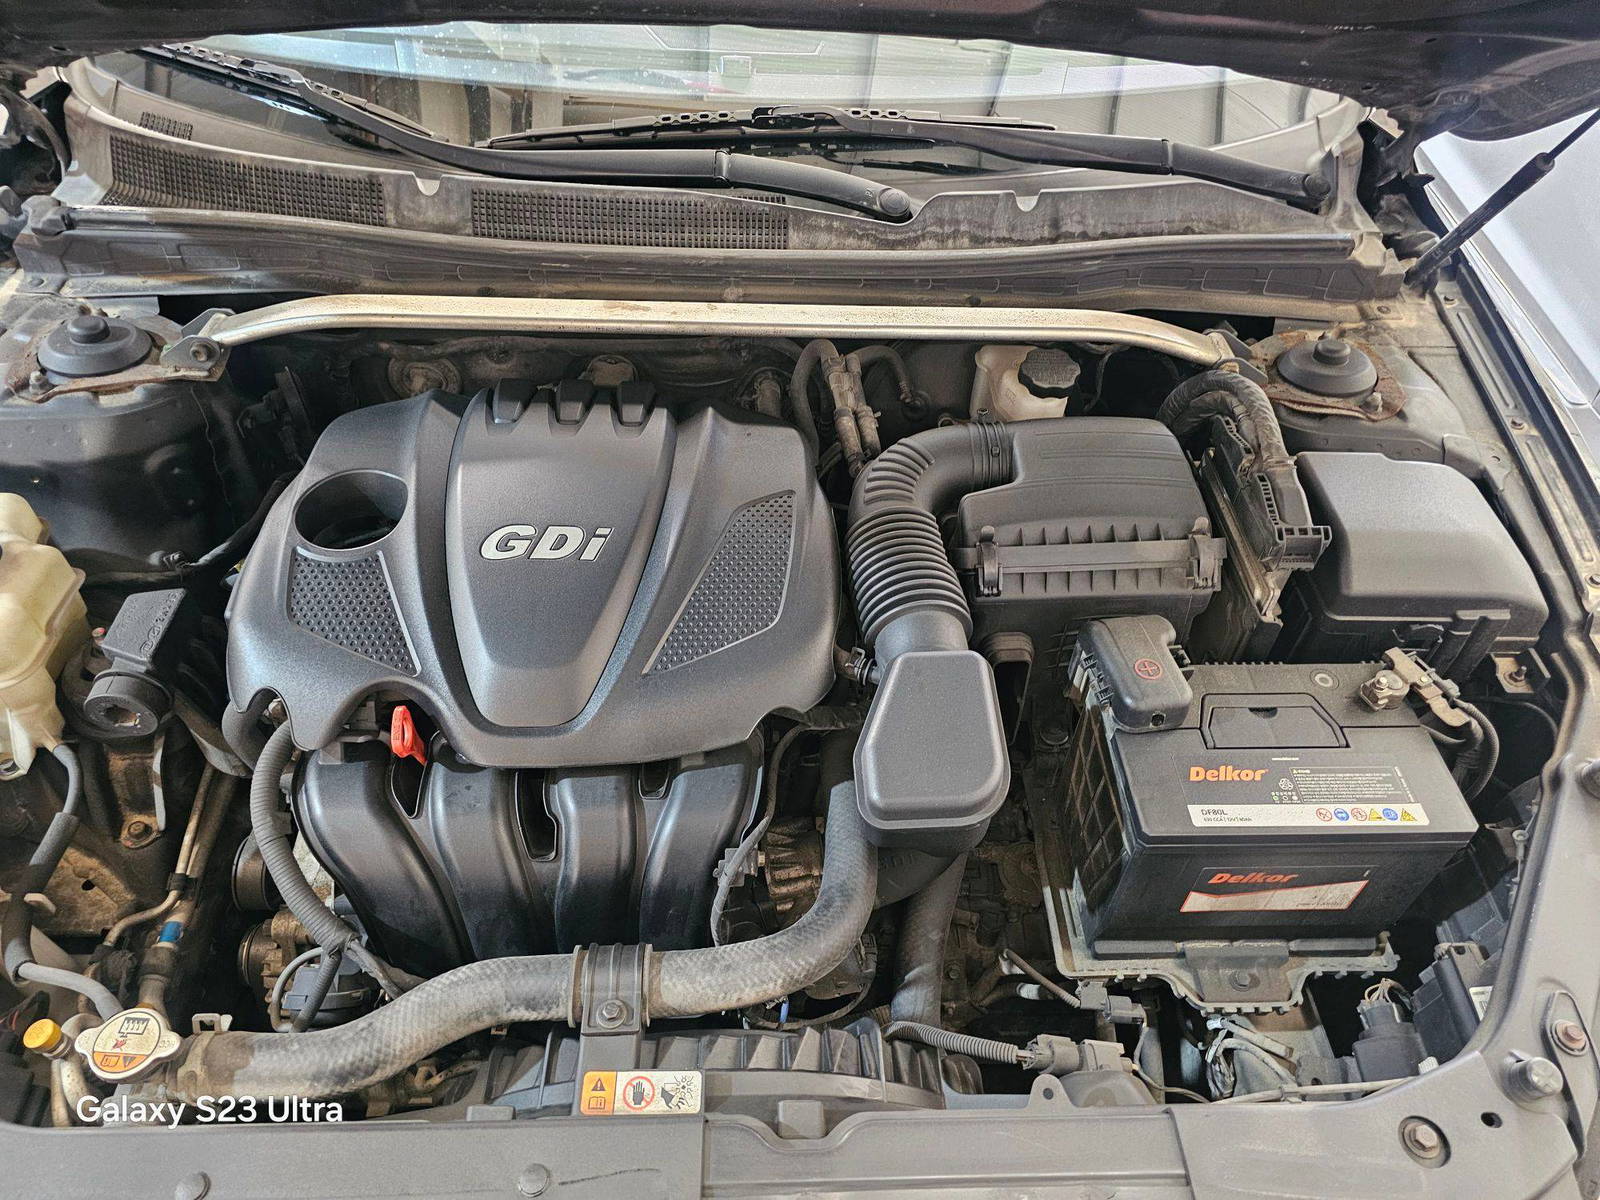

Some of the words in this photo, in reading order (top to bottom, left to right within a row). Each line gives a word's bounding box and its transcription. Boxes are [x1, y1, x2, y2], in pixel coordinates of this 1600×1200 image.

[480, 524, 614, 561] GDi
[1189, 765, 1267, 781] Delkor
[1208, 873, 1298, 884] Delkor
